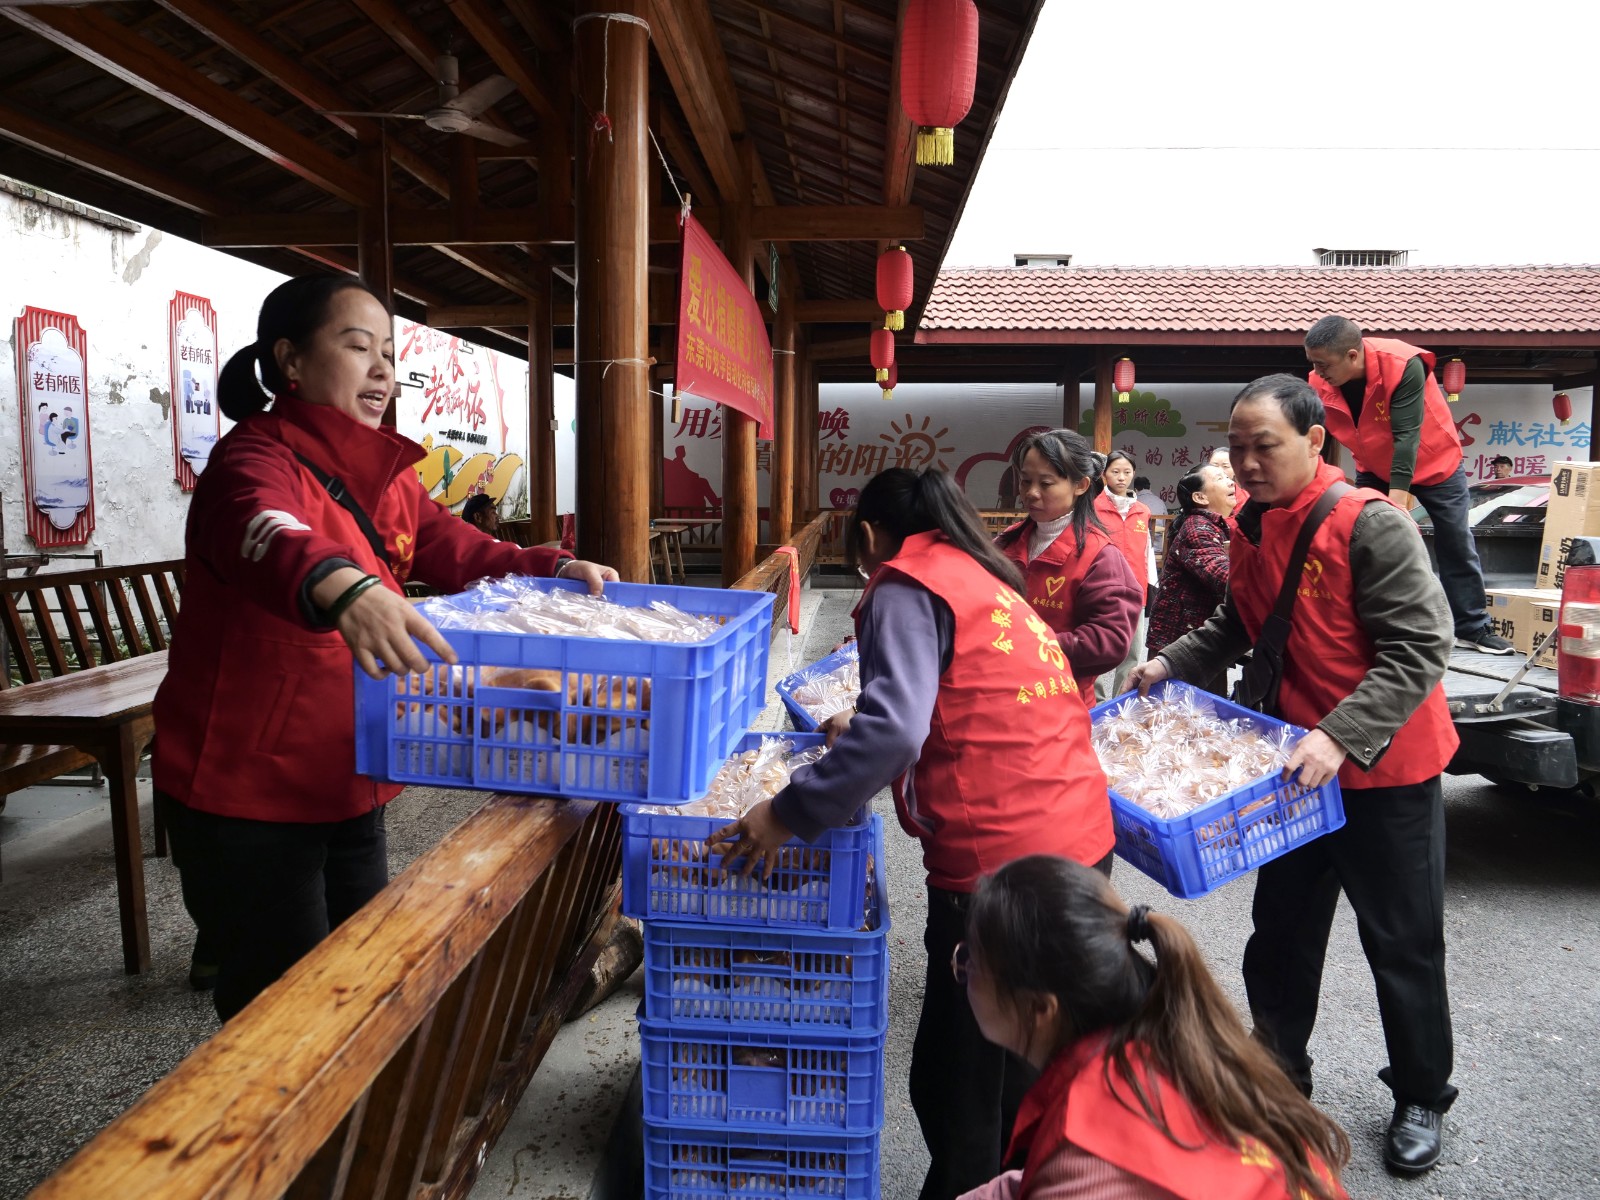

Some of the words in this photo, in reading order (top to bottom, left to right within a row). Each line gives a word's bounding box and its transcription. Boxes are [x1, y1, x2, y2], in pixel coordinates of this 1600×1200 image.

[180, 345, 213, 365] 老有所乐
[33, 371, 81, 395] 老有所医
[1487, 420, 1591, 448] 献社会
